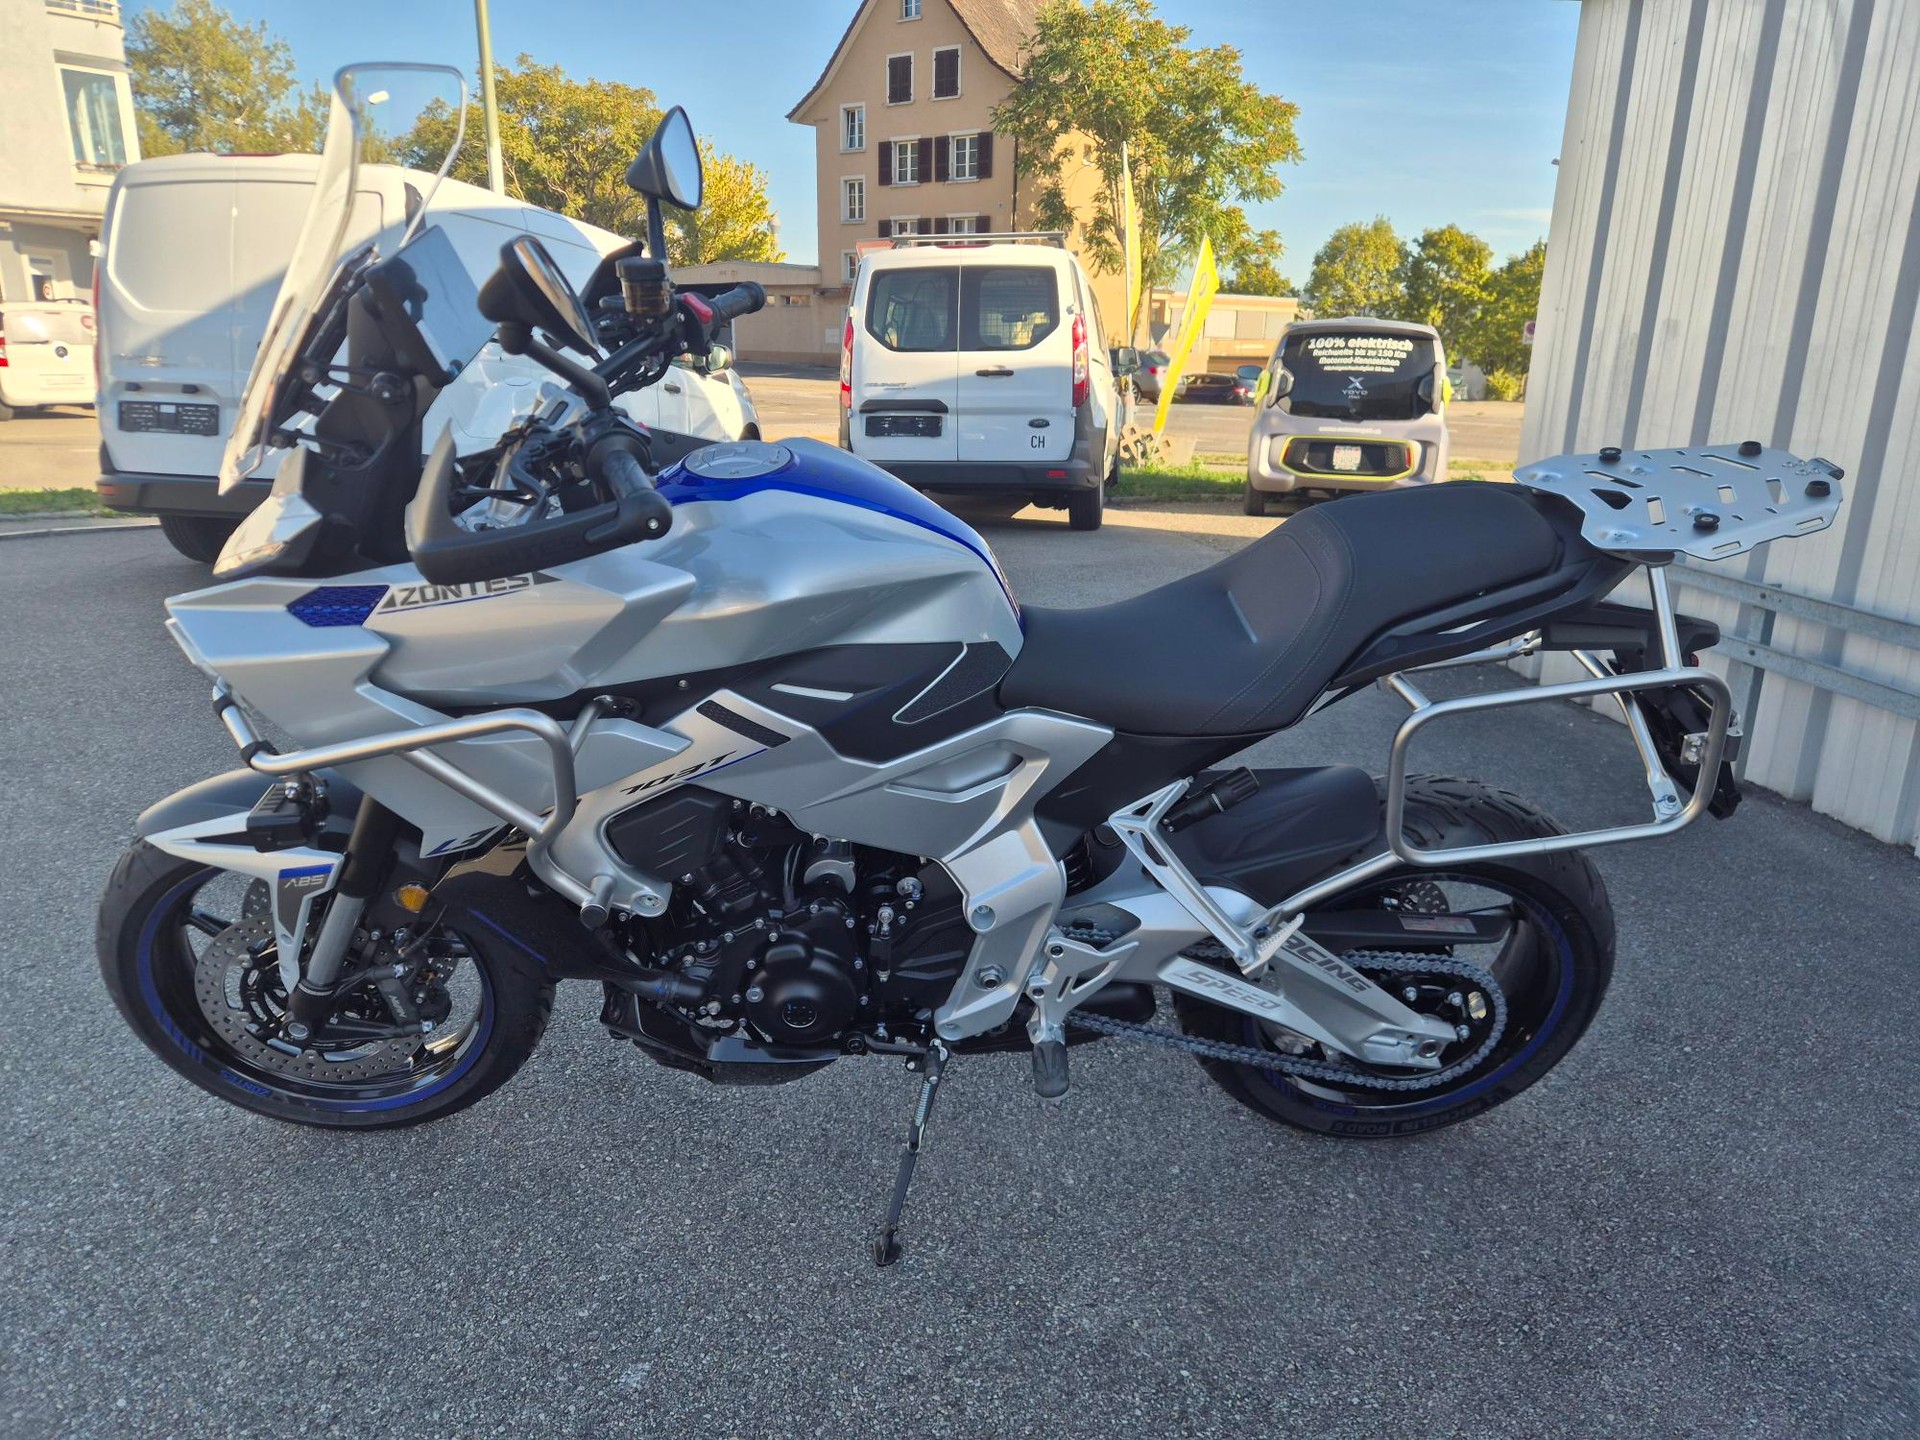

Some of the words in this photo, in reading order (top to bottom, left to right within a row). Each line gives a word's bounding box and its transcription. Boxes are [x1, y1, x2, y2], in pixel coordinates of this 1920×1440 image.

[1308, 337, 1346, 349] 100%
[1347, 338, 1413, 351] elektrisch
[1312, 349, 1354, 357] Reichweite
[1030, 435, 1045, 449] CH
[400, 575, 531, 606] ZONTES
[284, 874, 324, 889] ABS
[1281, 935, 1371, 993] ACING
[1178, 969, 1281, 1010] SPEED
[1400, 1101, 1483, 1132] MICHELIN
[1348, 1123, 1388, 1135] ROAD
